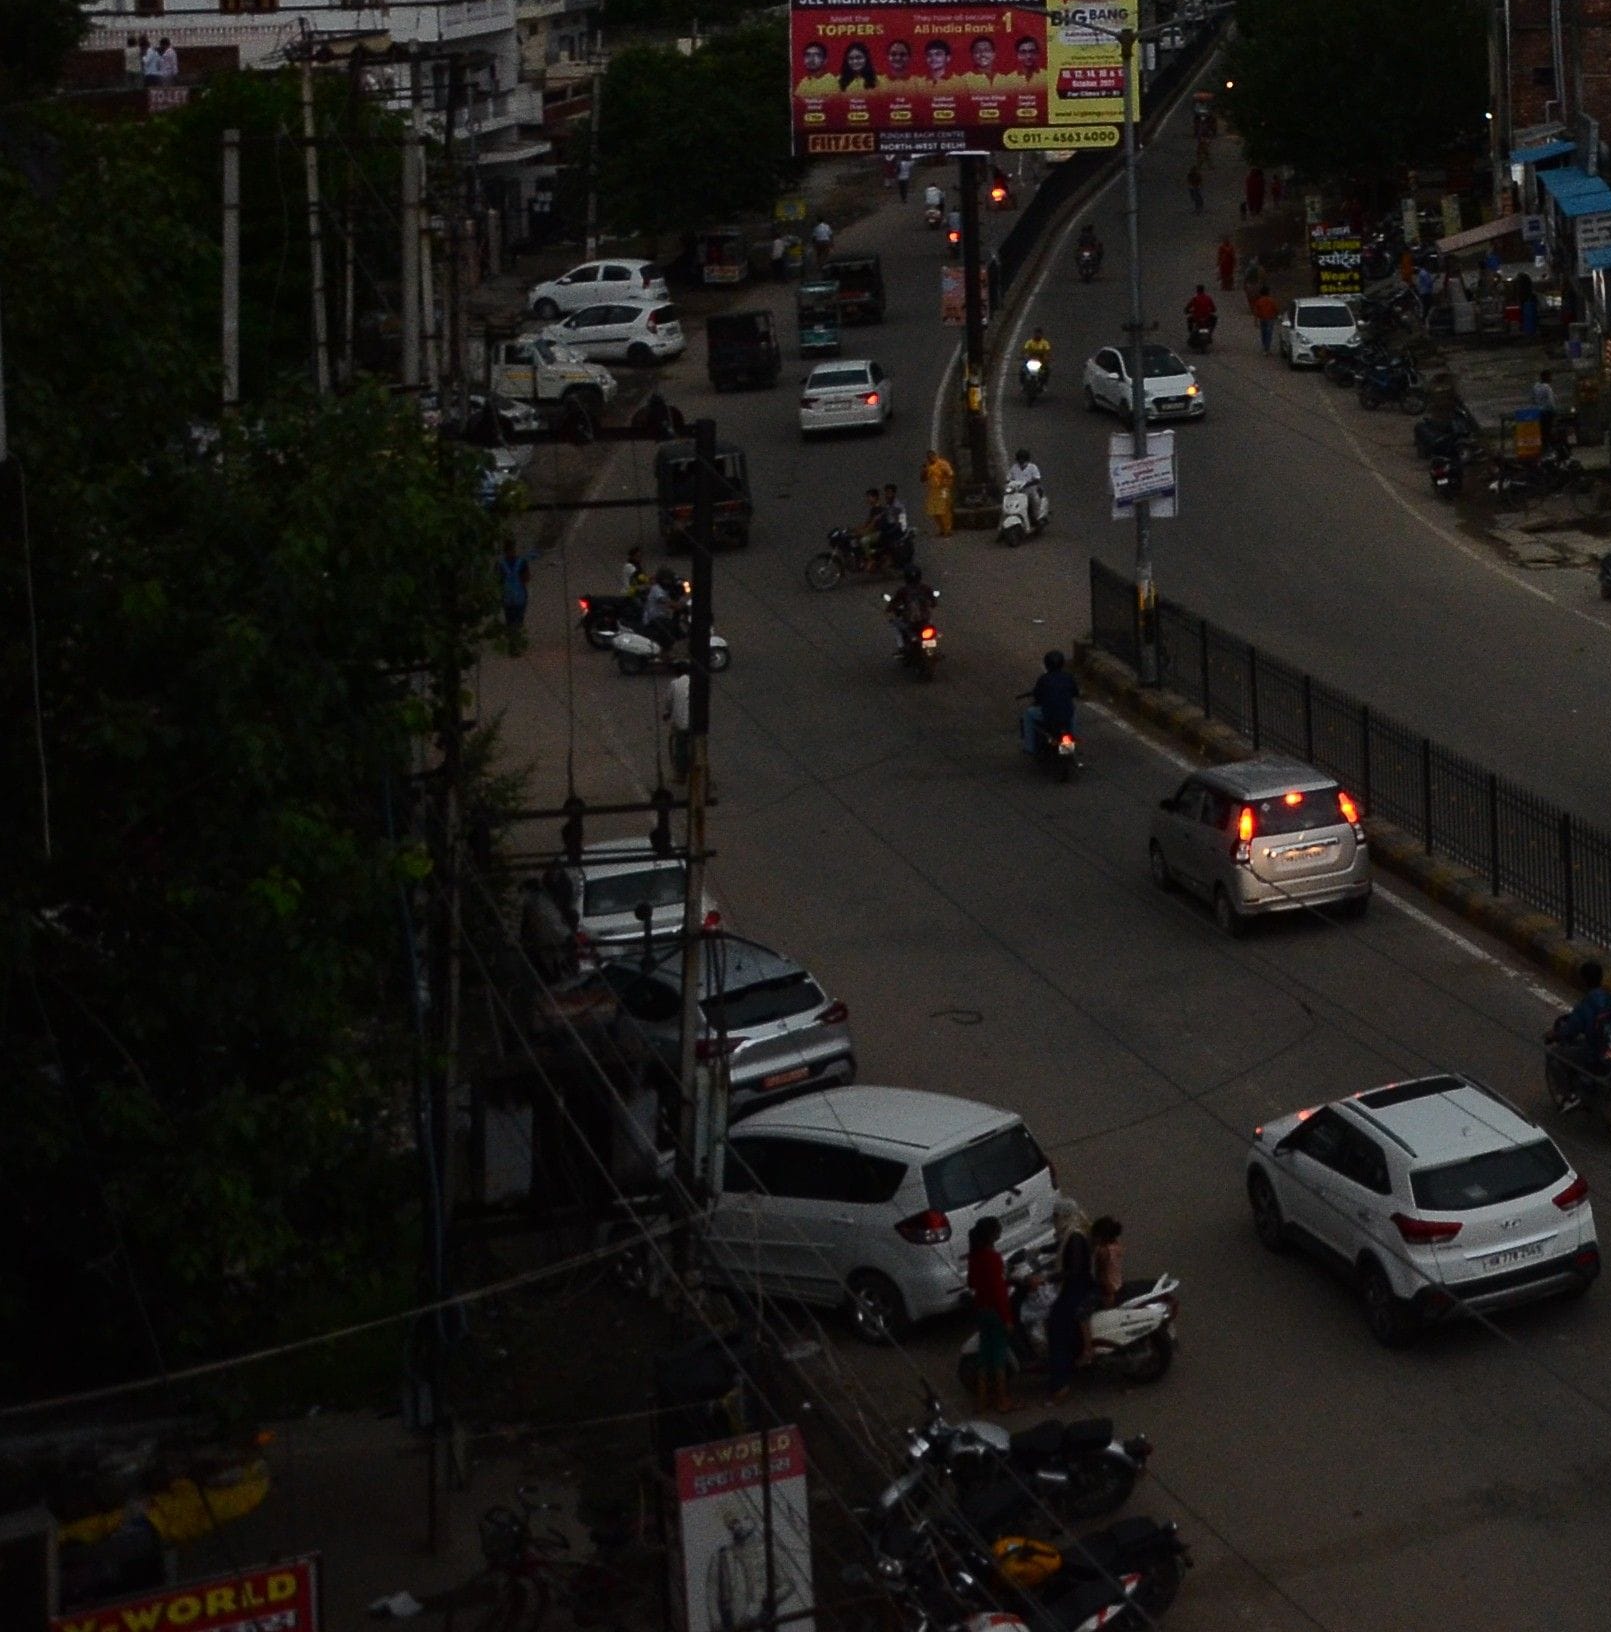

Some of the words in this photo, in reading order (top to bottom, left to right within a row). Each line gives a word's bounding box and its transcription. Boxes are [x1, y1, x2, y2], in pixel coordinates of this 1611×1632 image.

[1089, 8, 1128, 20] BANG
[931, 23, 962, 34] India
[963, 23, 995, 33] Rank
[1002, 11, 1013, 33] 1
[817, 24, 885, 36] TOPPERS
[1023, 133, 1041, 143] 011
[1083, 131, 1115, 142] 4000
[940, 141, 966, 150] DELHI
